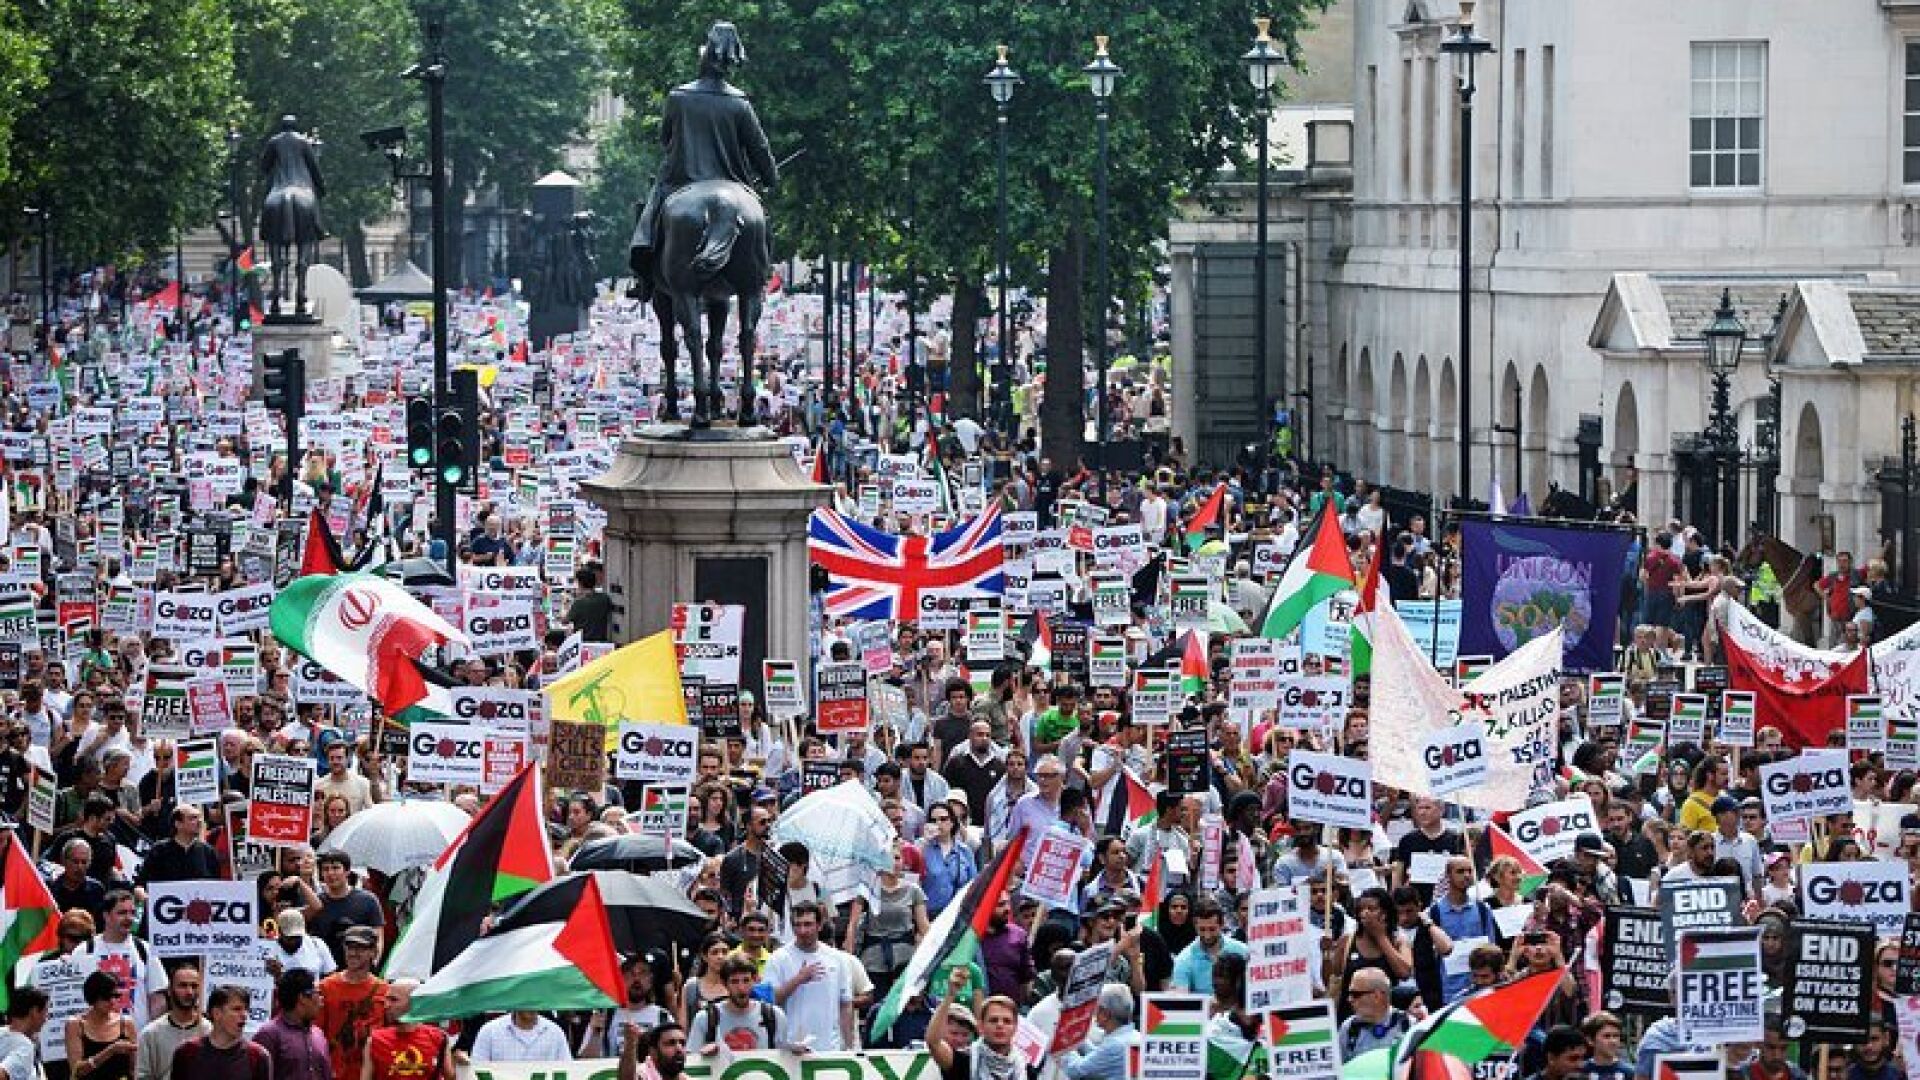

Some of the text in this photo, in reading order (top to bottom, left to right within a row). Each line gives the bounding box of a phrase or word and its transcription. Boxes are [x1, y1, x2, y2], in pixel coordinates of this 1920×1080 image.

[455, 696, 524, 719] Gaza
[622, 731, 692, 759] Gaza
[1425, 739, 1482, 770] Gaza
[1291, 763, 1366, 798] Gaza
[1767, 768, 1844, 796] Gaza
[1517, 813, 1592, 843] Gaza
[1673, 887, 1727, 912] END
[1808, 875, 1904, 906] Gaza
[153, 896, 250, 926] Gaza
[153, 933, 251, 948] End the siege
[1801, 934, 1859, 962] END
[1250, 957, 1307, 982] PALESTINE
[1795, 964, 1861, 980] ISRAEL'S
[1682, 971, 1758, 1002] FREE
[1794, 980, 1860, 997] ATTACKS
[1681, 1002, 1758, 1018] PALESTINE
[1793, 998, 1860, 1014] ON GAZA
[1146, 1040, 1200, 1054] FREE
[1274, 1047, 1332, 1065] FREE
